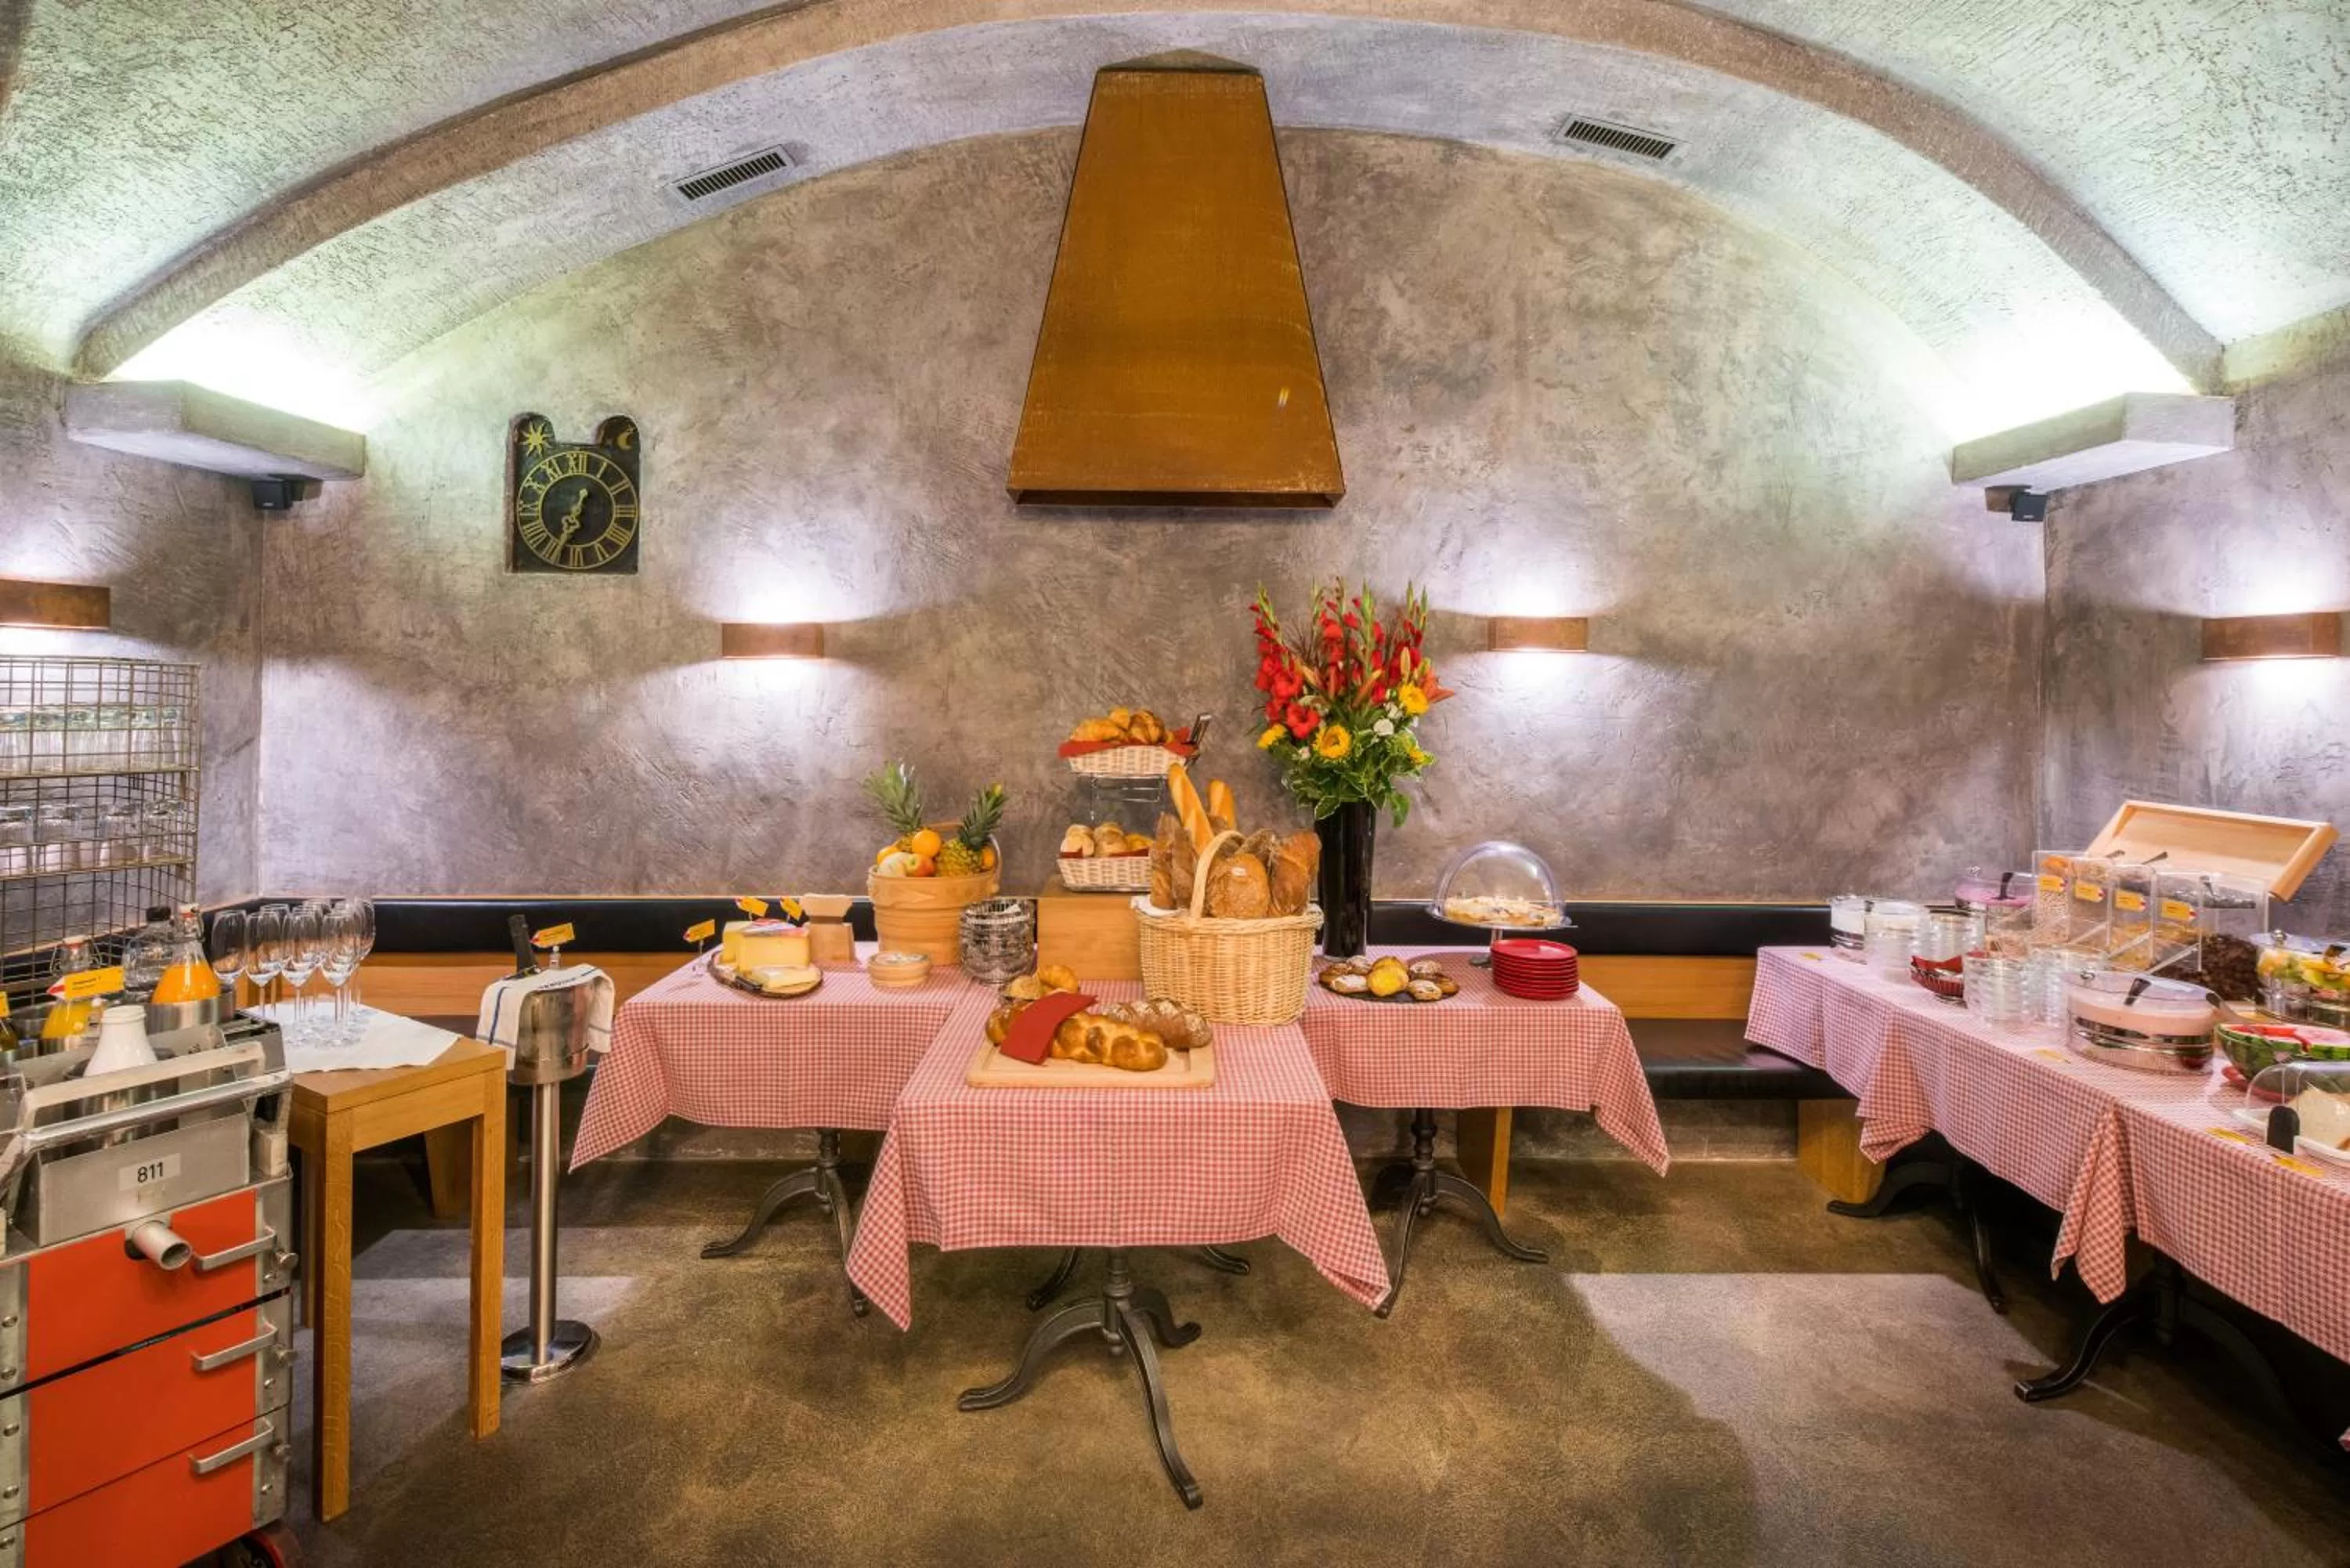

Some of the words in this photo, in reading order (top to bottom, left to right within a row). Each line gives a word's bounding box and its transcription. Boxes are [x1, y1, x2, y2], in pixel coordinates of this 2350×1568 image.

[541, 457, 562, 481] XI
[567, 452, 587, 473] XII
[523, 476, 547, 495] X
[609, 479, 630, 495] II
[519, 500, 540, 516] IX
[615, 504, 637, 518] III
[522, 521, 548, 547] VIII
[569, 547, 584, 567] VI
[594, 543, 609, 561] V
[137, 1162, 164, 1183] 811
